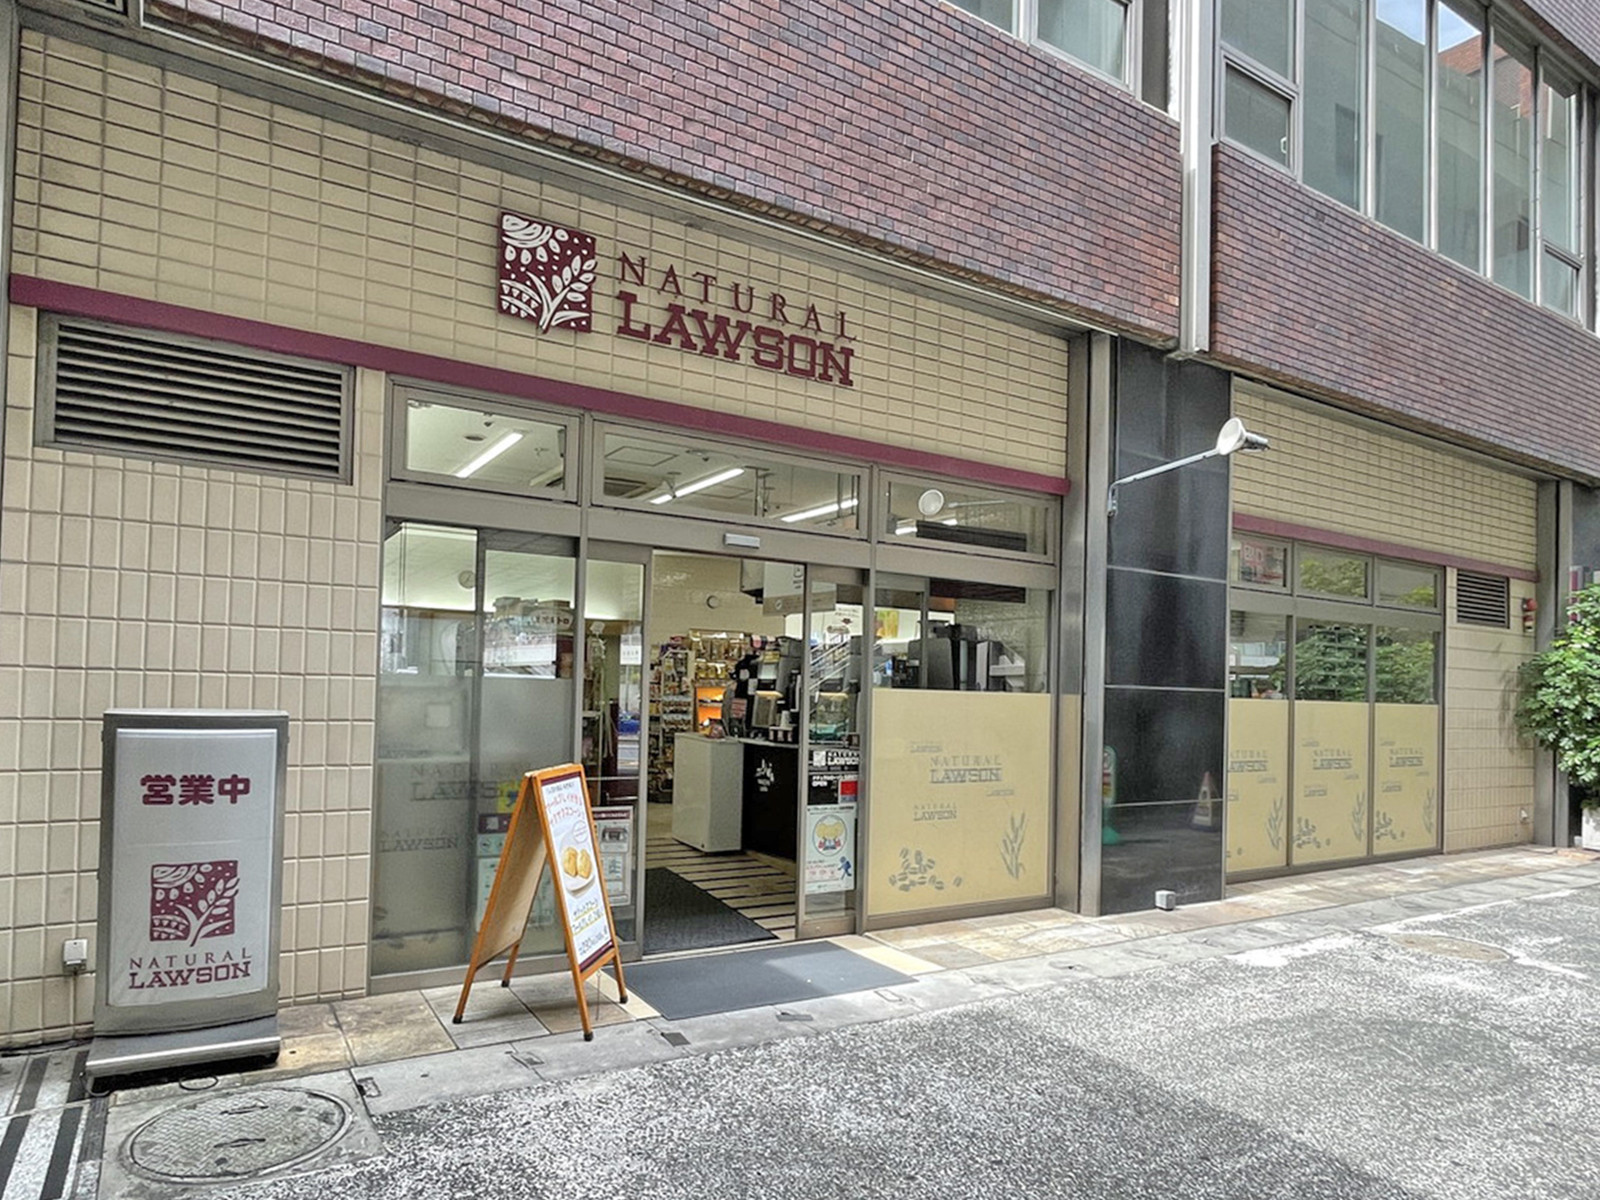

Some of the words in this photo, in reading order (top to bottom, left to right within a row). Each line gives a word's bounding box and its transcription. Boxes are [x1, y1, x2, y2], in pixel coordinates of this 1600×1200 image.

[618, 251, 857, 342] NATURAL
[616, 290, 855, 387] LAWSON
[930, 755, 1002, 767] NATURAL
[1228, 760, 1269, 773] AWSON
[930, 768, 1002, 784] LAWSON
[140, 774, 251, 805] 営業中
[379, 837, 459, 853] LAWSON
[129, 948, 252, 970] NATURAL
[129, 961, 252, 989] LAWSON
